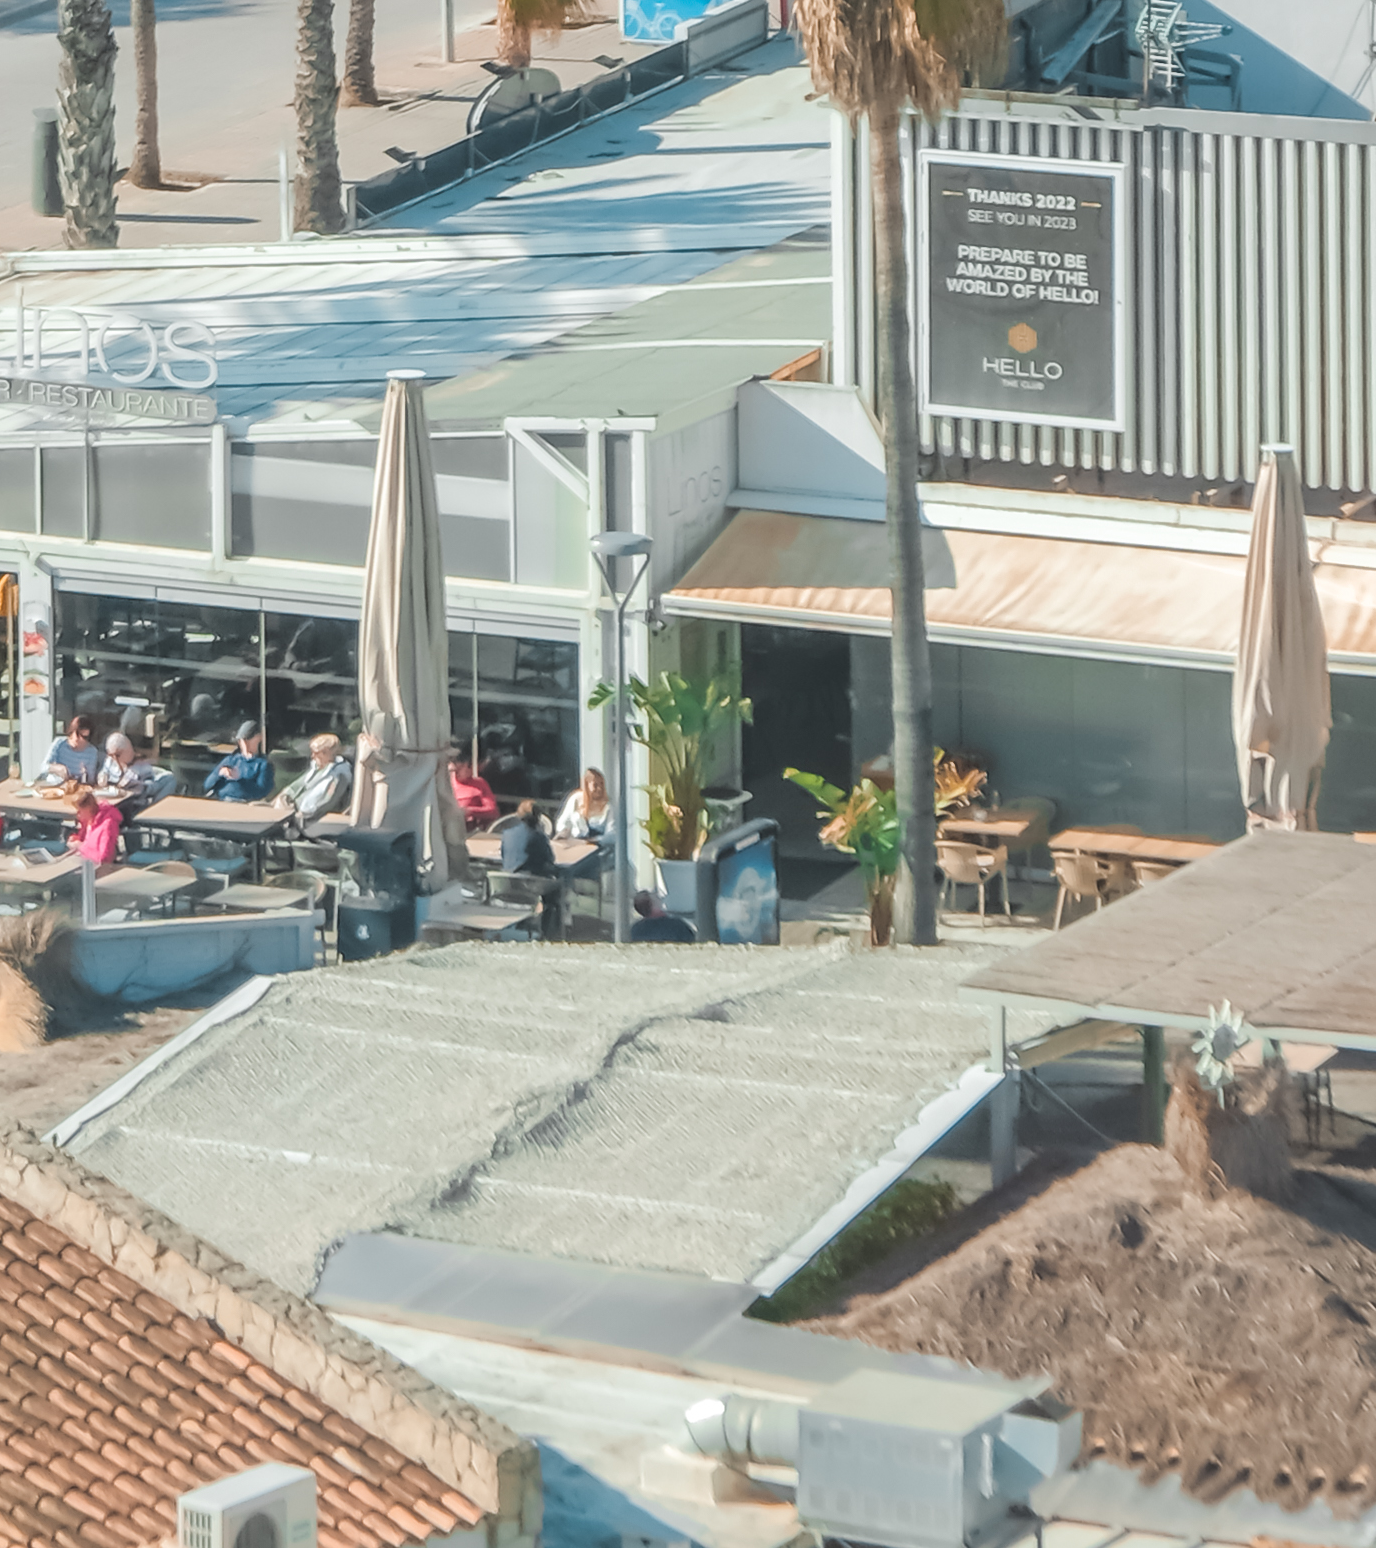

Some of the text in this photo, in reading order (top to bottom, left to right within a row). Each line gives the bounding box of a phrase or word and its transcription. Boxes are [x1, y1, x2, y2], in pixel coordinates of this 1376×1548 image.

[967, 188, 1077, 210] THANKS 2022
[967, 209, 1077, 230] SEE YOU IN 2023
[957, 244, 1087, 269] PREPARE TO BE
[956, 262, 1089, 286] AMAZED BY THE
[946, 277, 1099, 305] WORLD OF HELLO!
[982, 357, 1063, 379] HELLO
[28, 381, 209, 420] RESTAURANTE
